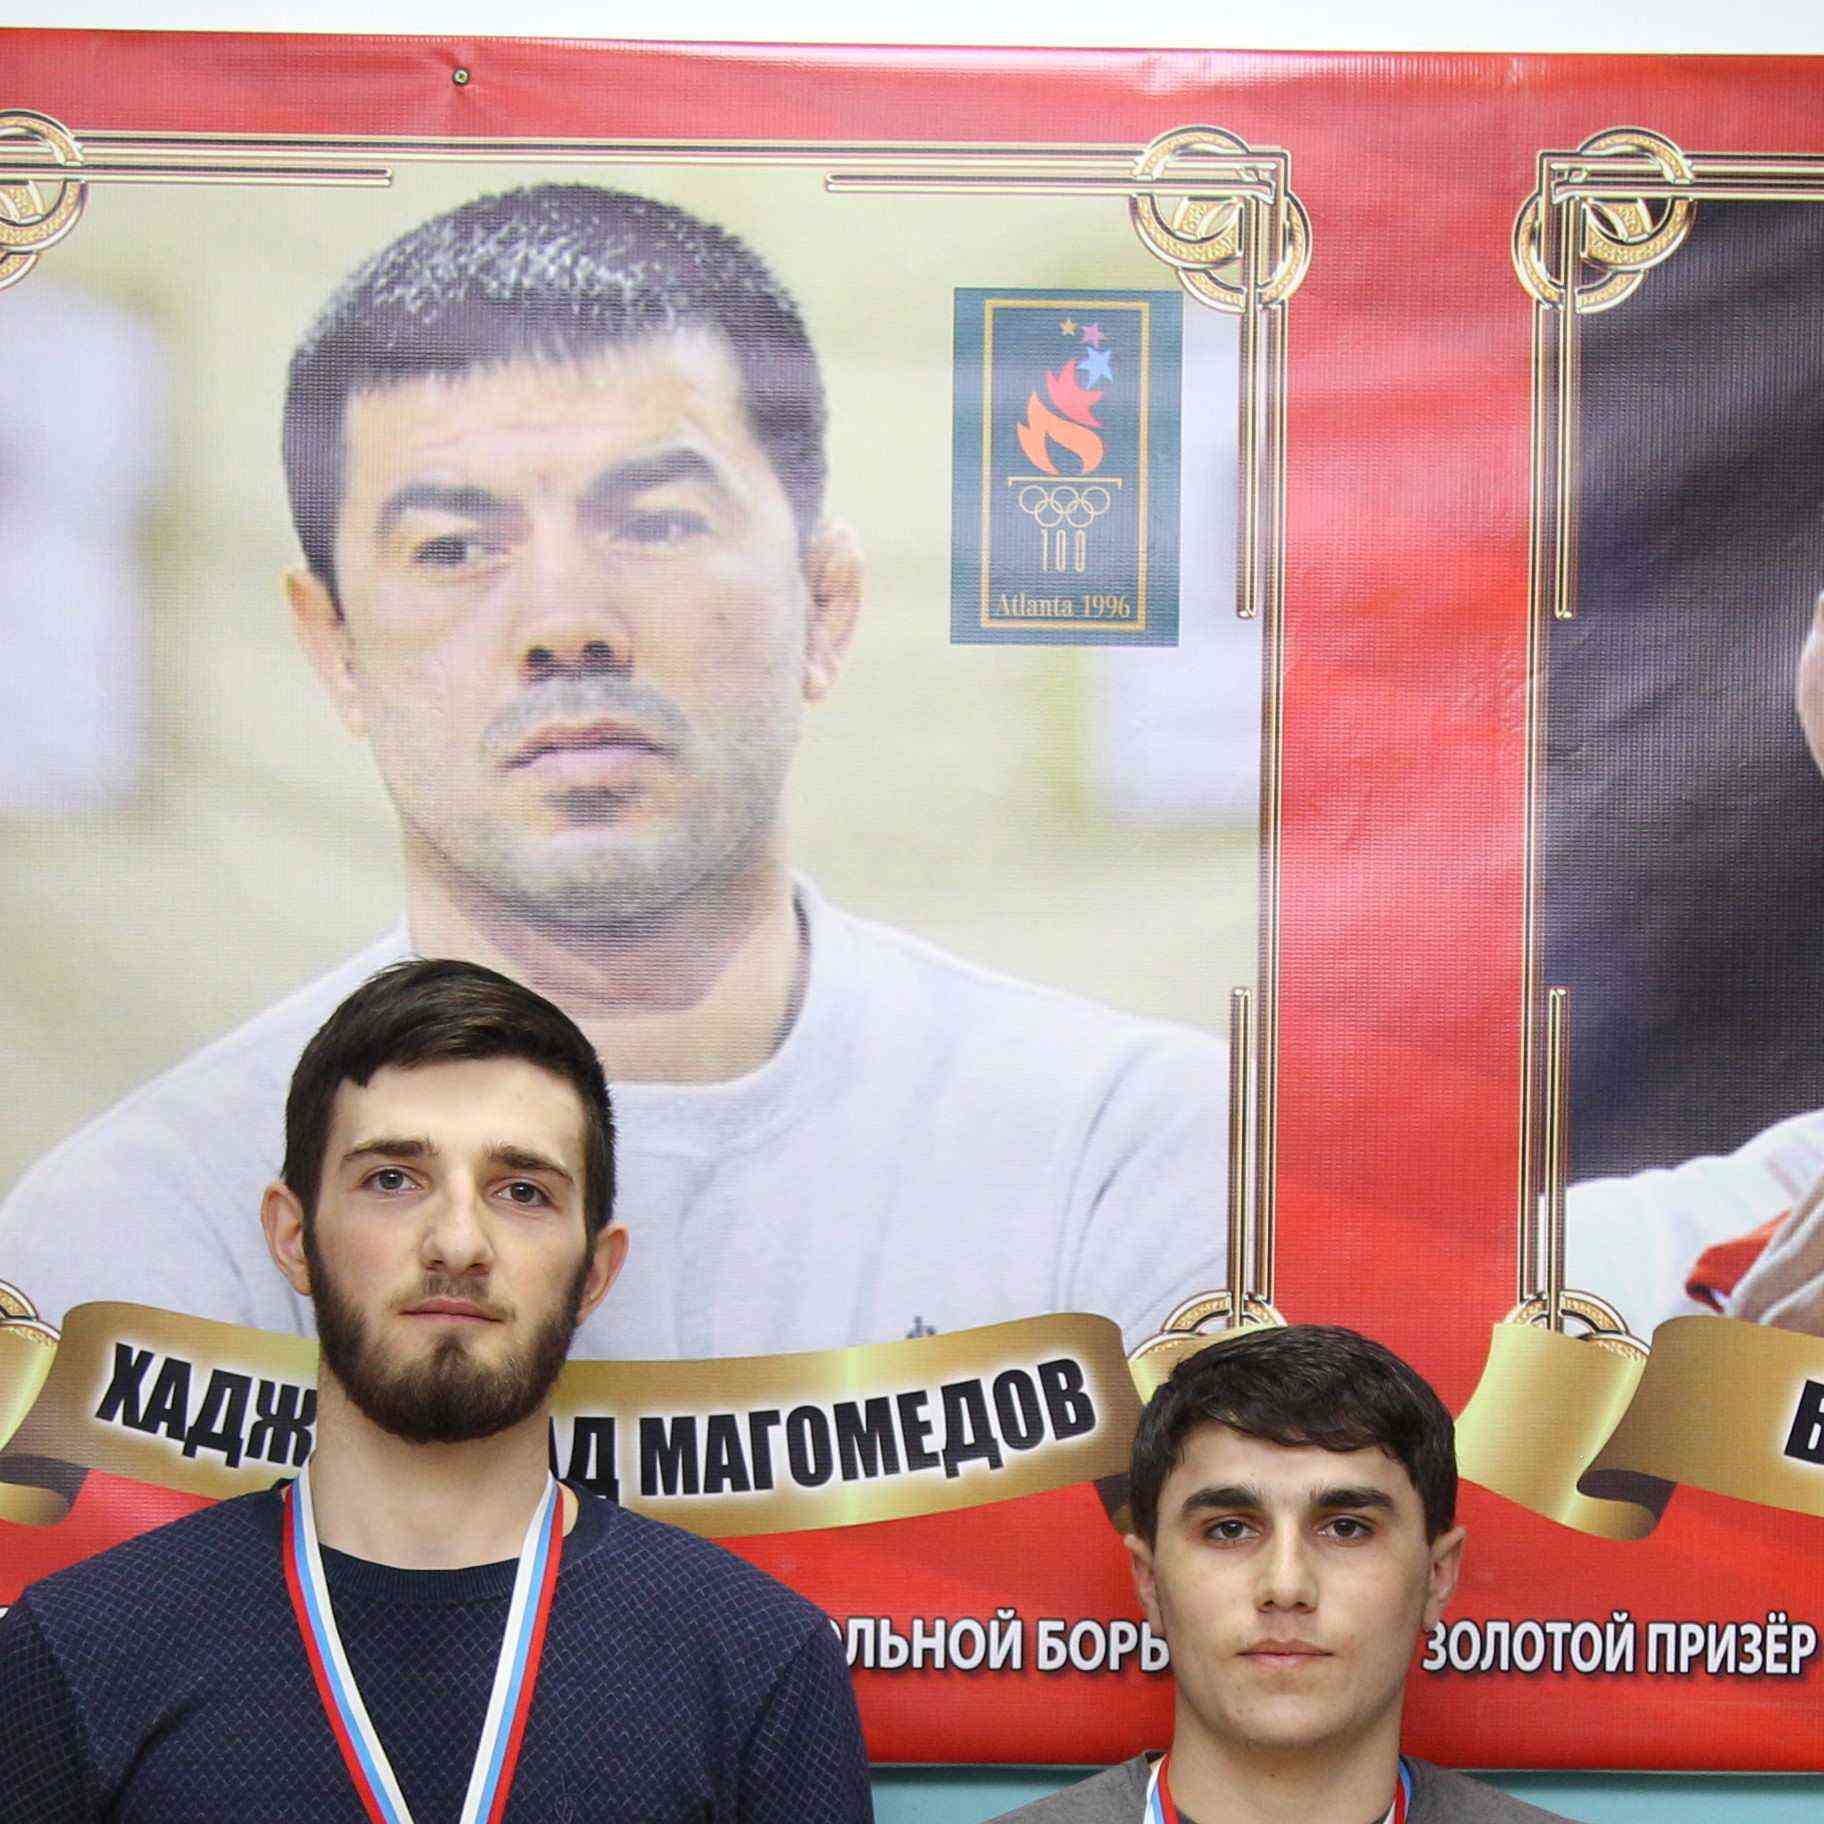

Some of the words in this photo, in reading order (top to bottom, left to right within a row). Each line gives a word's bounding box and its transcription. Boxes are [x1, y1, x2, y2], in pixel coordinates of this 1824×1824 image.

[996, 592, 1074, 618] Atlanta
[1082, 593, 1131, 618] 1996
[639, 1357, 1096, 1497] МАГОМЕДОВ
[829, 1607, 1024, 1671] ЛЬНОЙ
[1036, 1618, 1170, 1672] БОРЬ
[1421, 1610, 1636, 1674] ЗОЛОТОЙ
[1646, 1611, 1818, 1677] ПРИЗЁР
